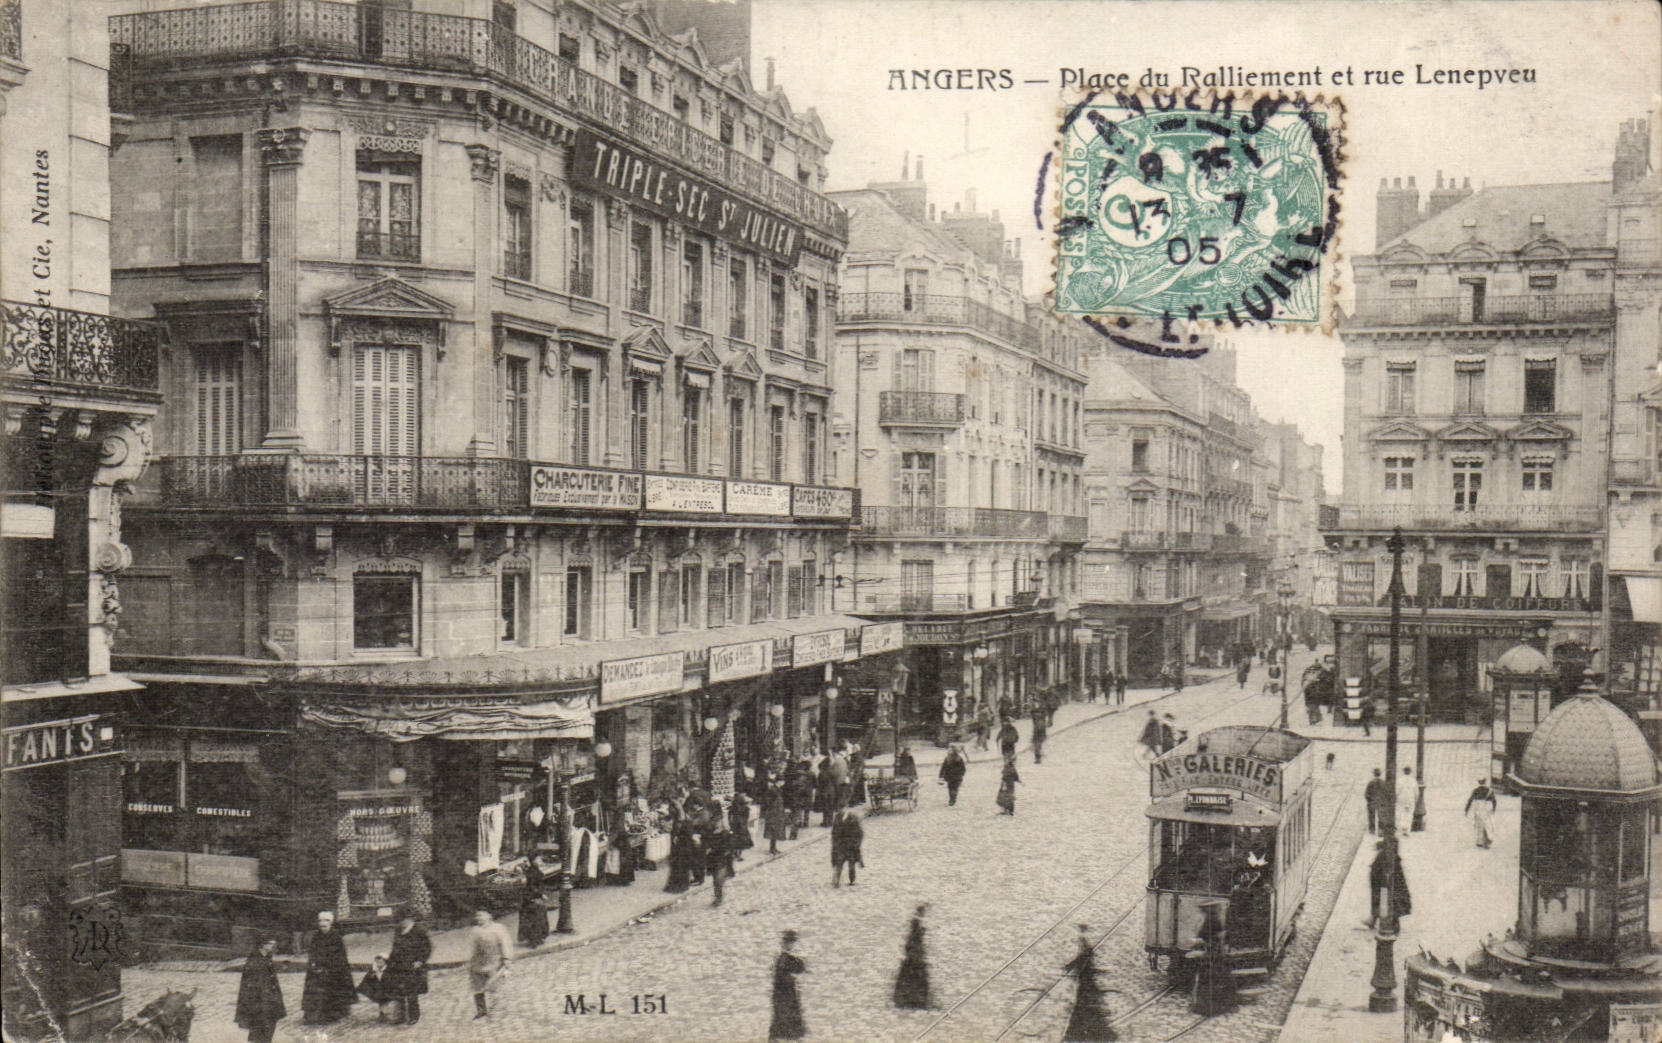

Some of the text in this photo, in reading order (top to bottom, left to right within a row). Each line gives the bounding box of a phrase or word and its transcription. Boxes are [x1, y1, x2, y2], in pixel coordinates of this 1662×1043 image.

[740, 210, 797, 257] JULIEN
[1167, 236, 1222, 266] 05
[534, 468, 641, 494] CHARCUTERIE FINE
[1457, 597, 1479, 610] DE
[1492, 597, 1582, 611] COIFFURE
[1184, 754, 1278, 787] GALERIES
[197, 807, 252, 818] COMESTIBLES
